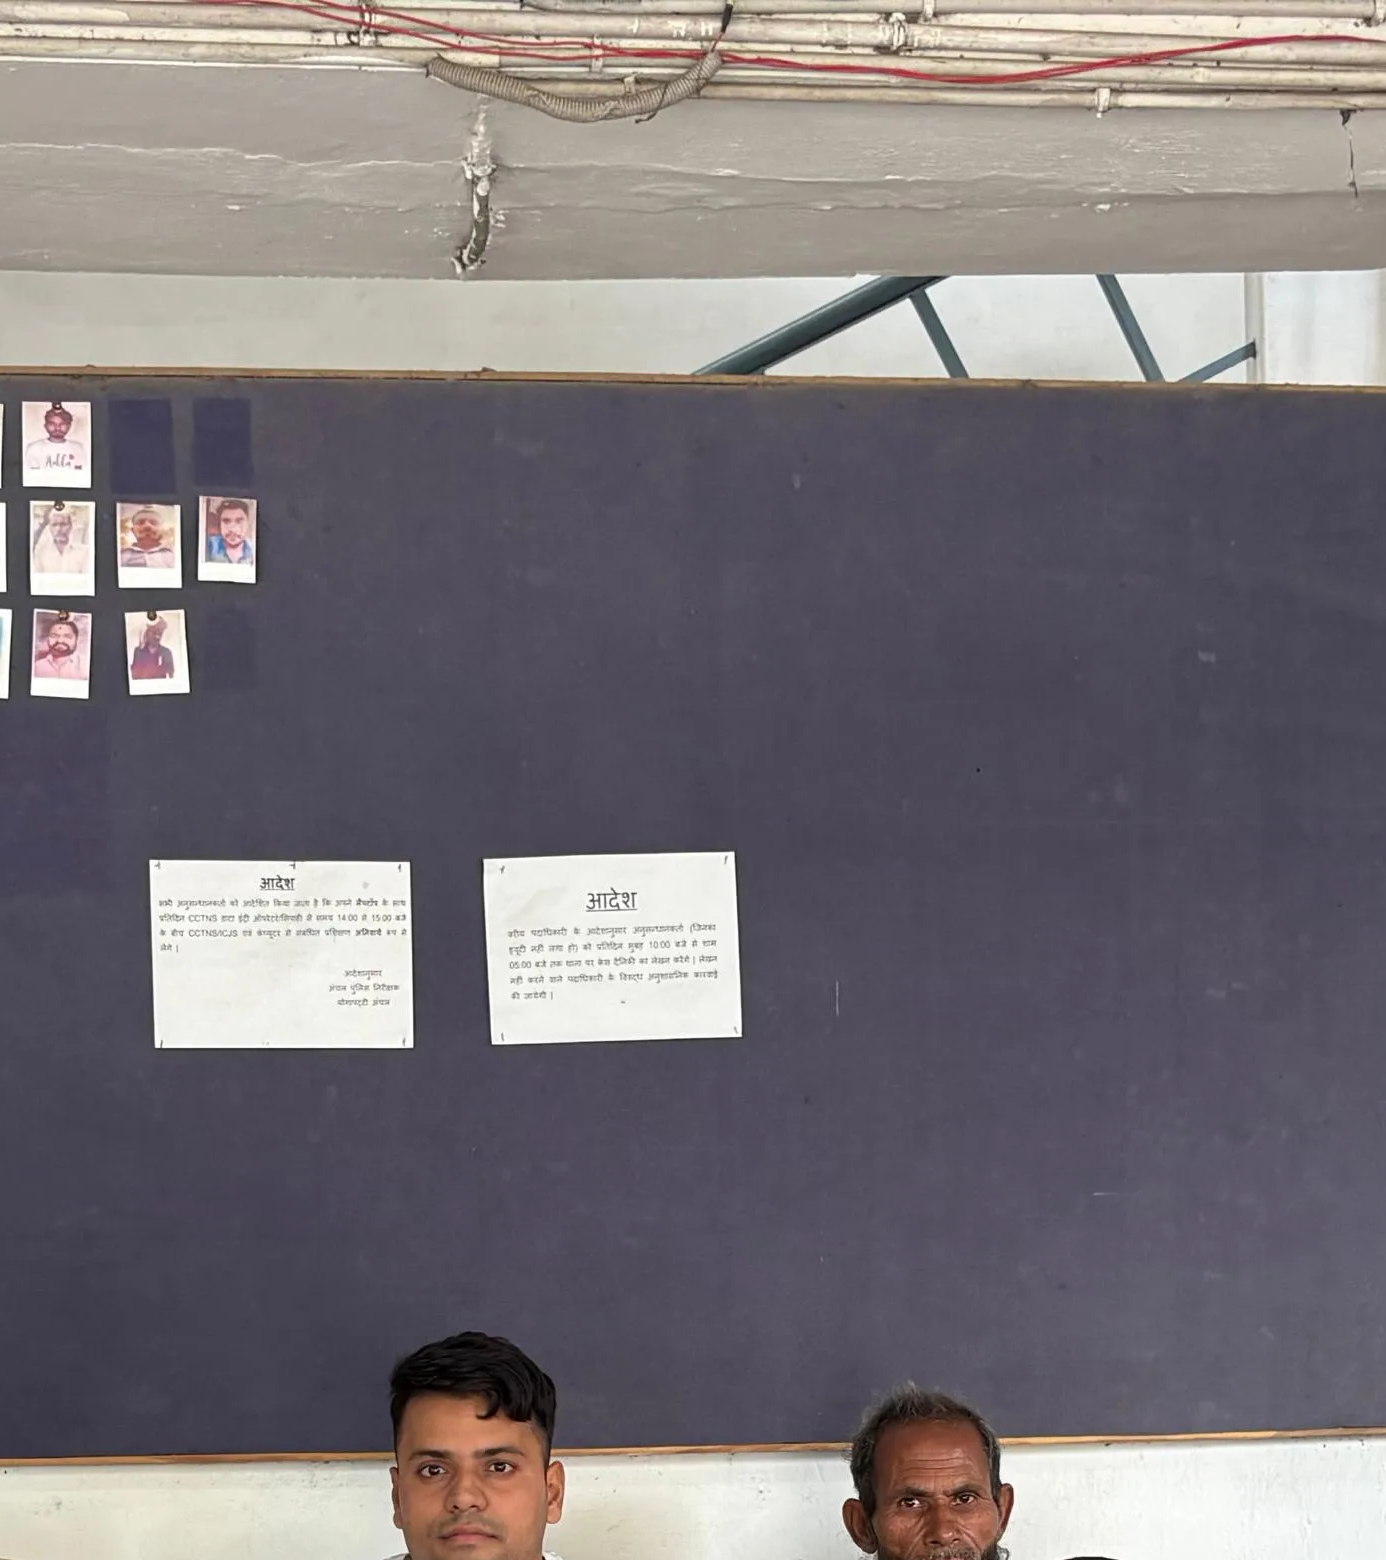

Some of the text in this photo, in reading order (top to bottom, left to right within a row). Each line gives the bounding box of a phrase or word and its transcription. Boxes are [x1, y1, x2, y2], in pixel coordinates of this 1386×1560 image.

[260, 876, 295, 891] आदेश
[585, 887, 637, 911] आदेश
[188, 914, 218, 923] CCTNS
[649, 940, 671, 950] 10:00
